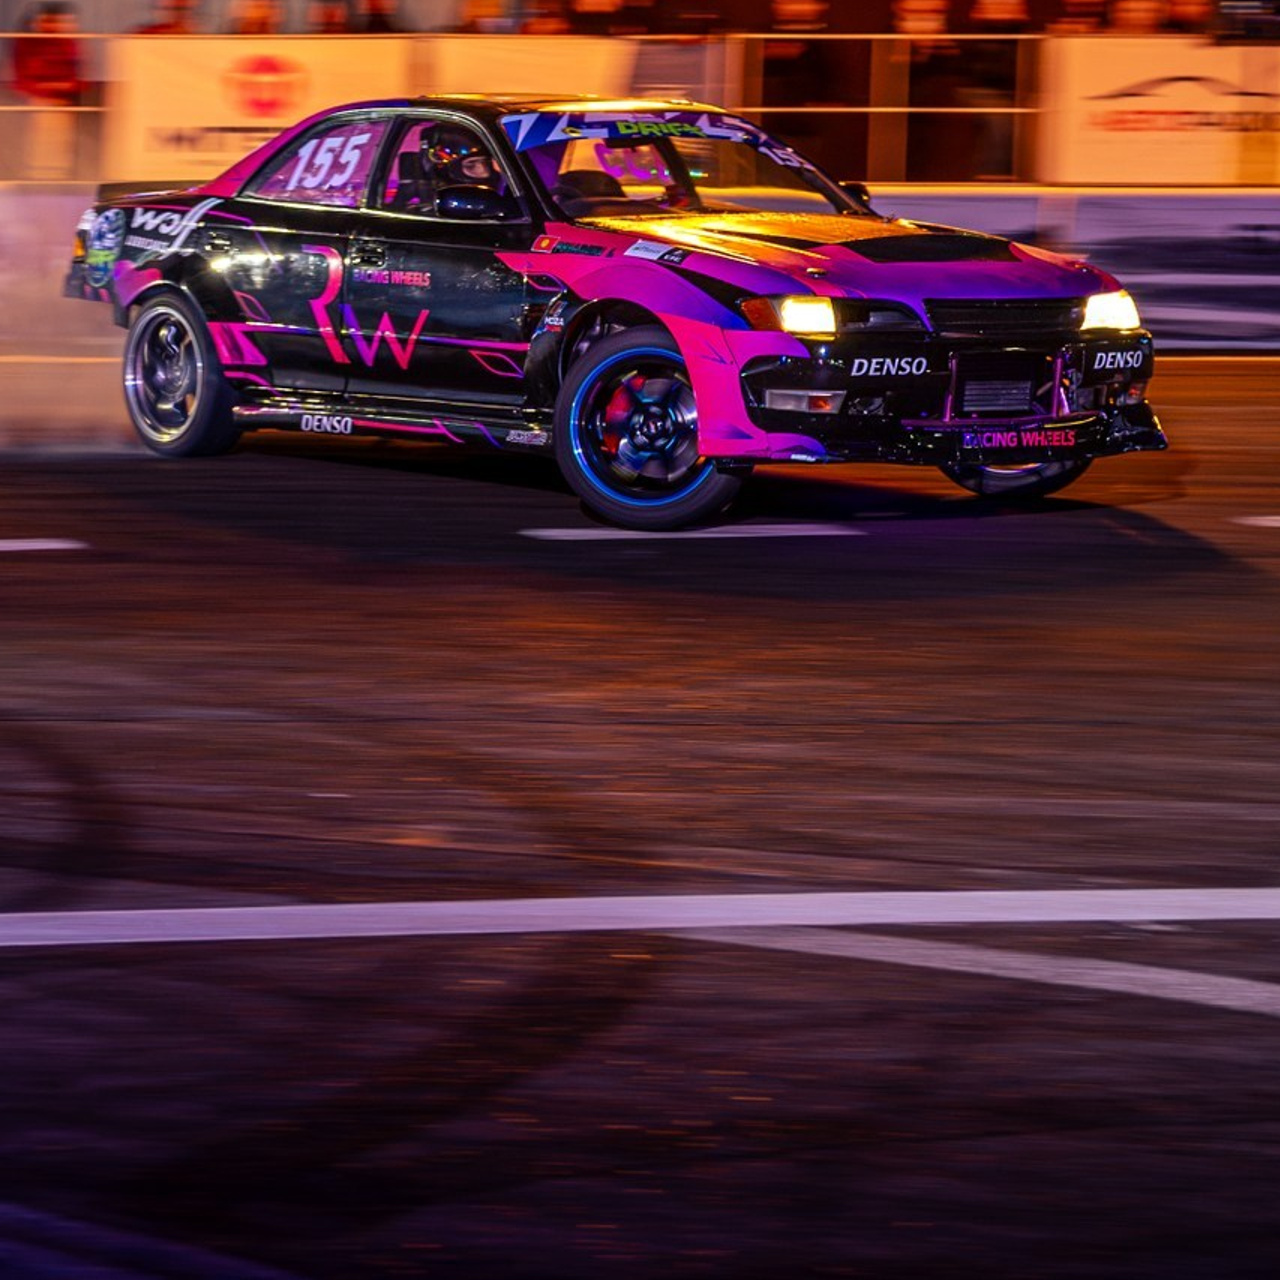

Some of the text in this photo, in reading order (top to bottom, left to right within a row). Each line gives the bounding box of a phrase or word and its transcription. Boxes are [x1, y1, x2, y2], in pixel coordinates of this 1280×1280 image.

[286, 131, 372, 192] 155
[391, 270, 431, 287] WHEELS
[850, 357, 927, 377] DENSO
[1094, 350, 1144, 370] DENSO
[301, 414, 352, 434] DENSO
[963, 430, 1076, 449] RACING WHEELS
